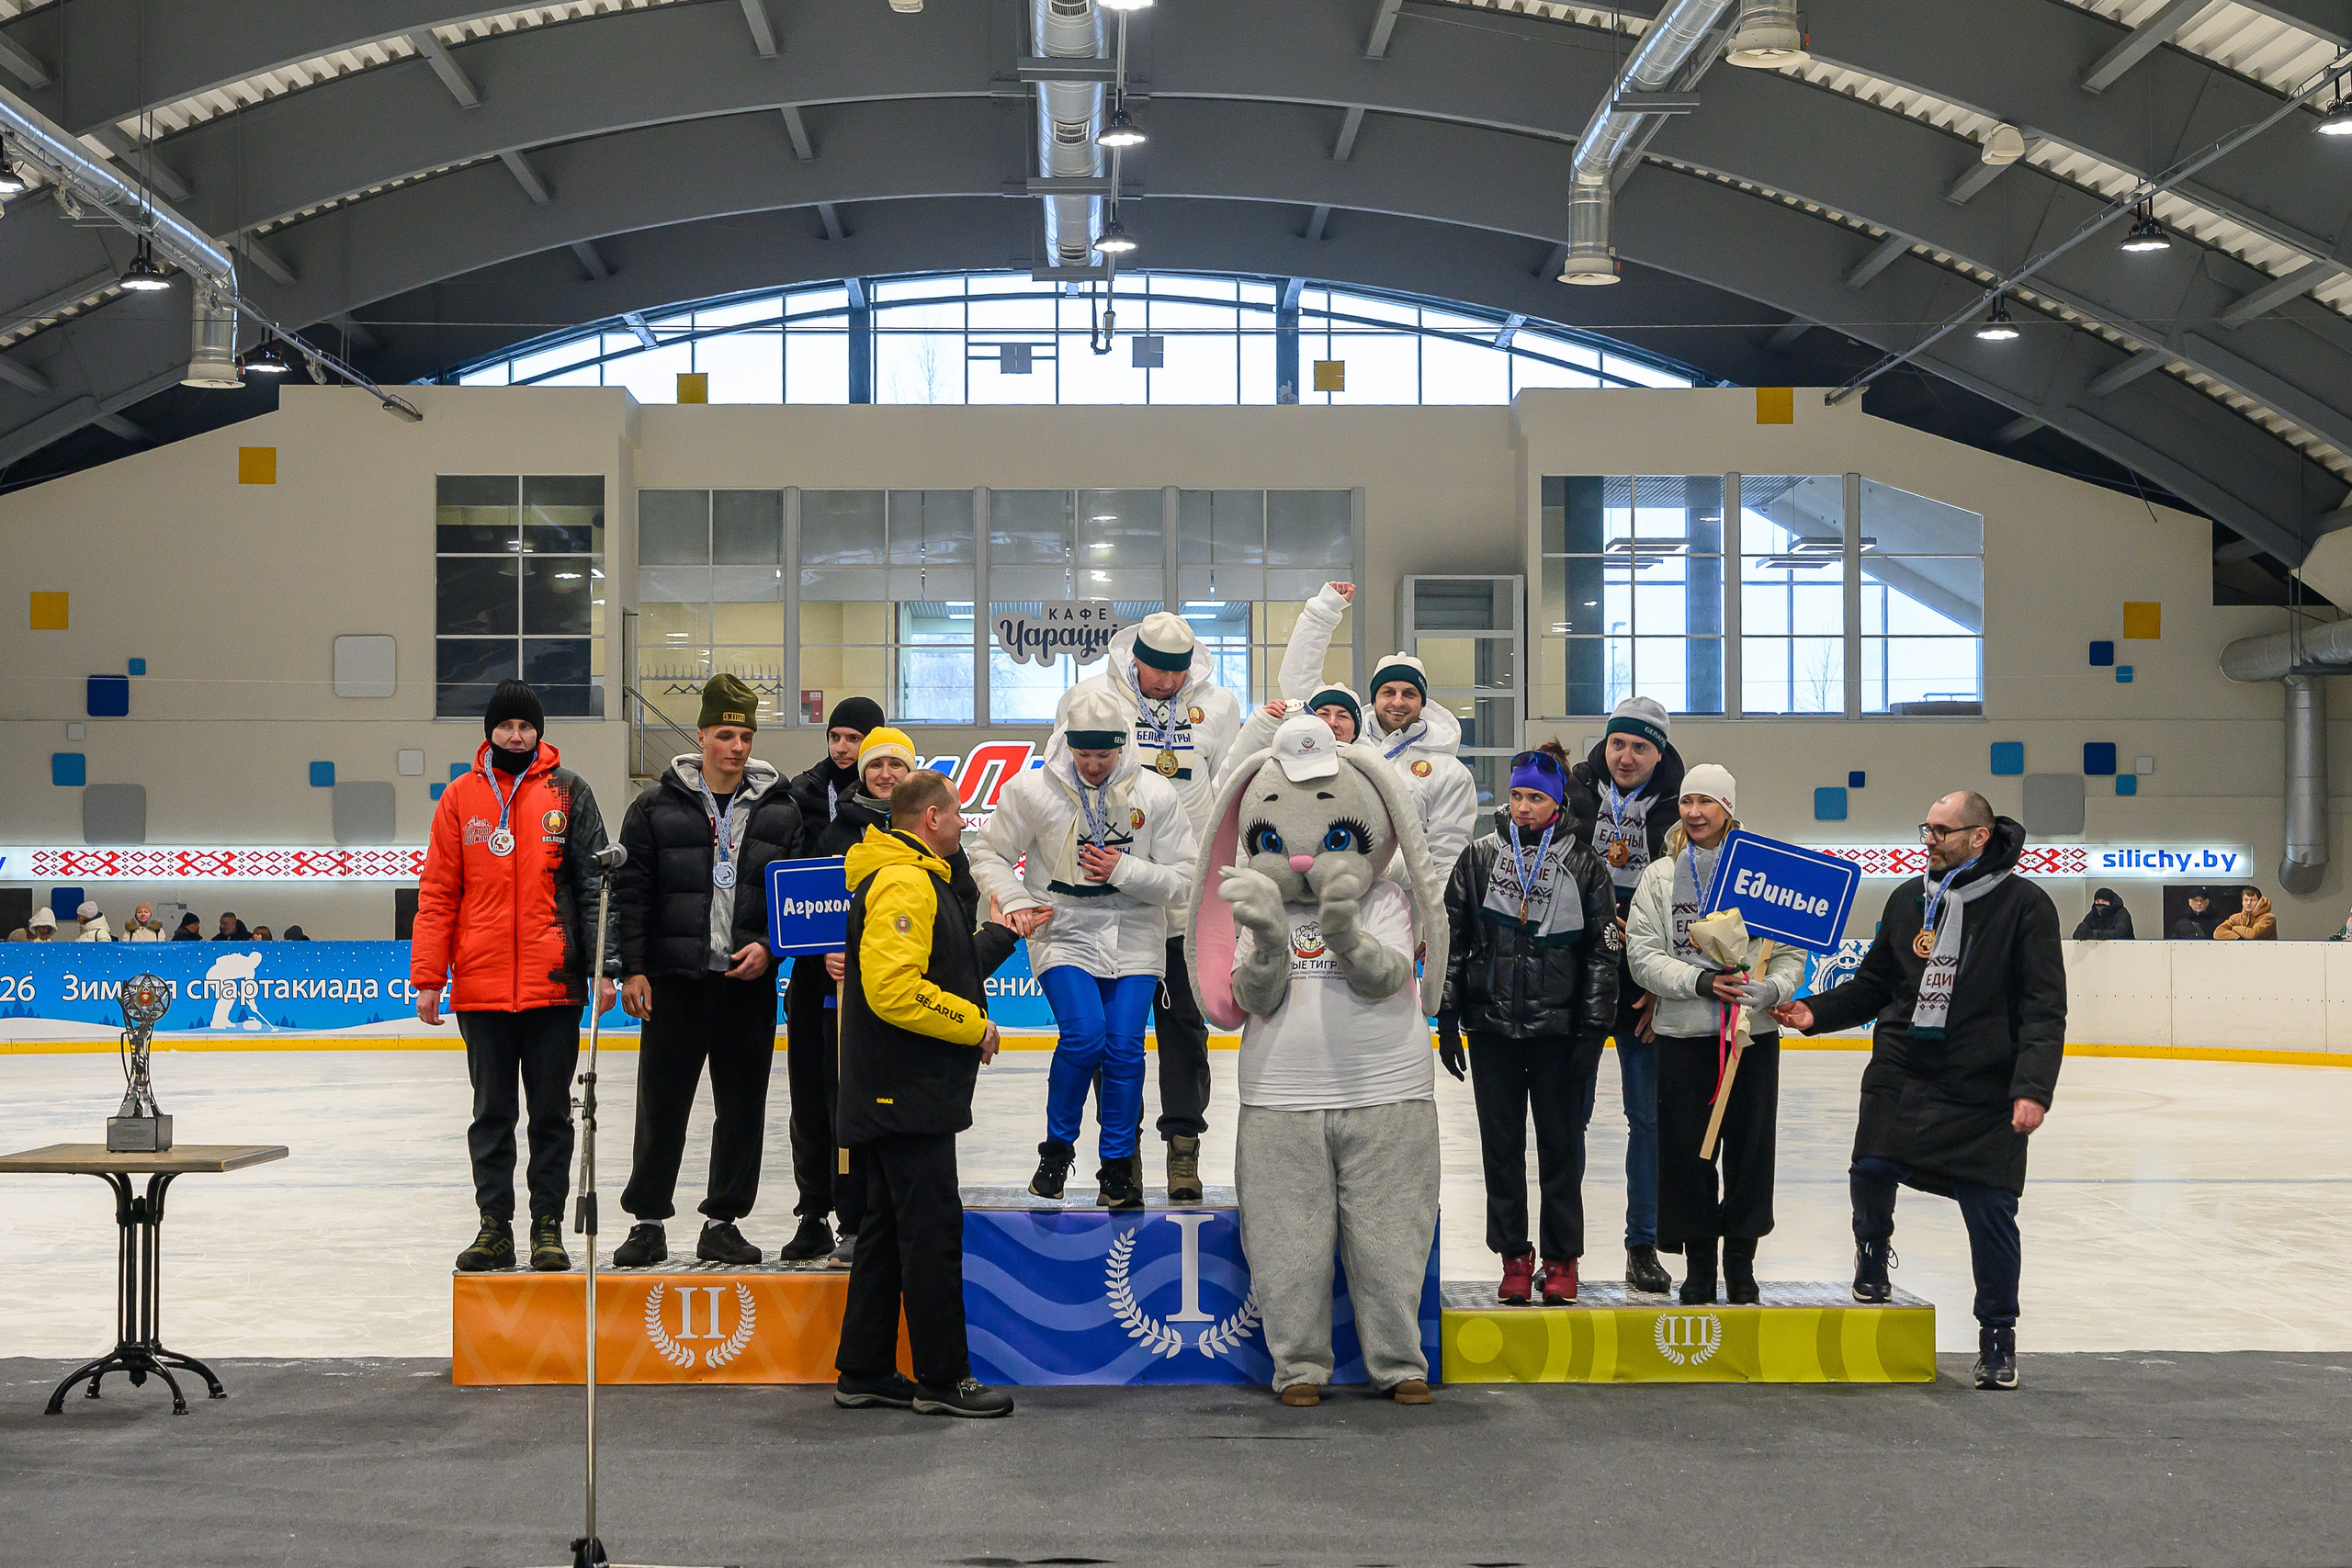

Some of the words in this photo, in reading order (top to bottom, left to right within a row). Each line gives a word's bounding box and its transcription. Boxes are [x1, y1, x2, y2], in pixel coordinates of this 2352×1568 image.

[1048, 607, 1107, 621] КАФЕ
[1000, 619, 1118, 660] Чараўні
[2103, 849, 2237, 872] silichy.by
[783, 894, 854, 919] Агрохол
[1734, 868, 1829, 917] Единые
[1309, 960, 1340, 970] ТИГР
[186, 977, 379, 1004] спартакиада
[915, 993, 965, 1024] BELARUS
[1166, 1214, 1215, 1322] I
[674, 1287, 726, 1339] II
[1667, 1316, 1711, 1346] III
